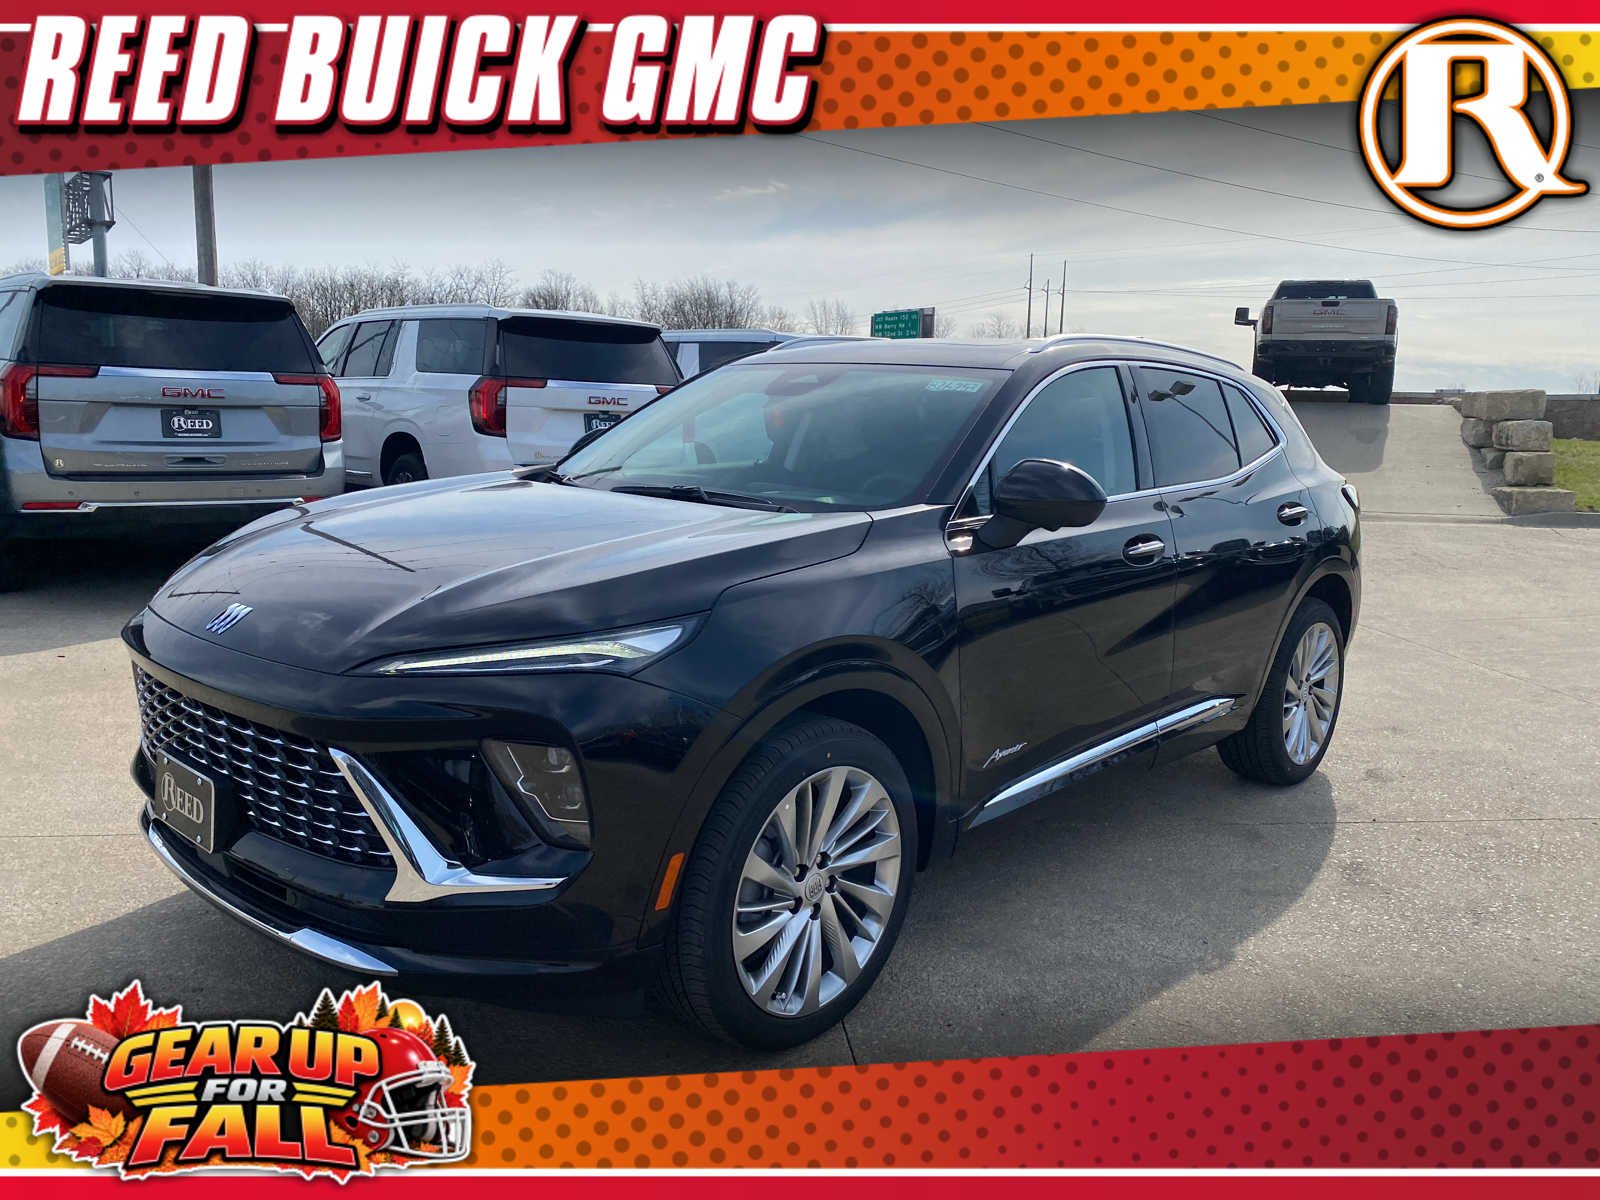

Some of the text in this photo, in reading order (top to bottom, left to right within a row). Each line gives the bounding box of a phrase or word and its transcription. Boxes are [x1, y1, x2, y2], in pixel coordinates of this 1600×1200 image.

[161, 386, 225, 399] GMC
[588, 395, 628, 406] GMC
[171, 415, 213, 431] REED
[161, 772, 204, 824] REED
